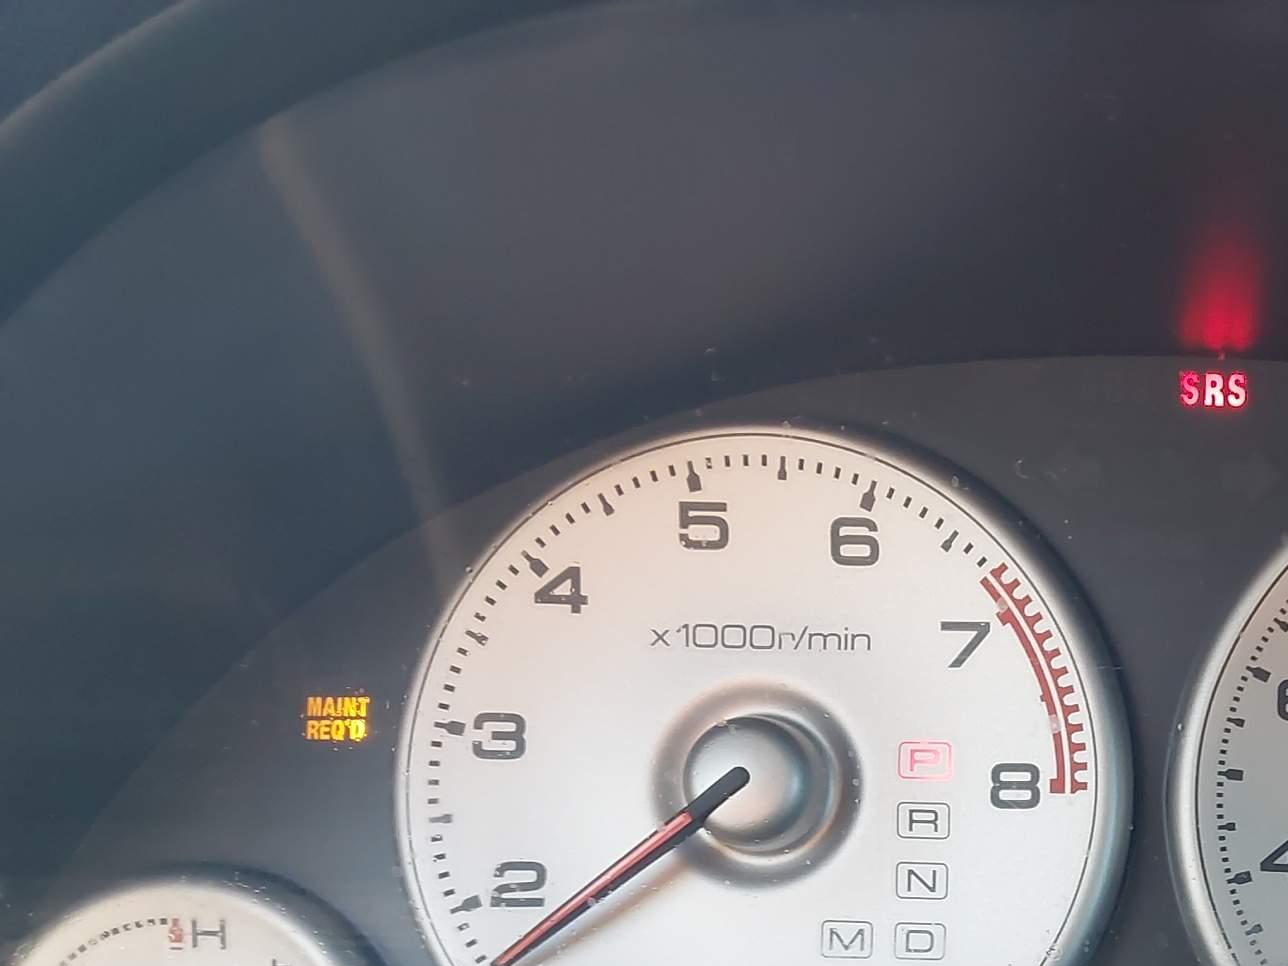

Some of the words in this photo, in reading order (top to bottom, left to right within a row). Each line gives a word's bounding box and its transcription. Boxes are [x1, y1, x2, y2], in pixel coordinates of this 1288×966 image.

[1180, 370, 1247, 407] SRS
[678, 501, 728, 550] 5
[830, 517, 880, 566] 6
[534, 566, 588, 614] 4
[940, 621, 991, 669] 7
[307, 695, 370, 718] MAINT
[307, 719, 366, 742] REQ'D
[472, 712, 527, 761] 3
[908, 749, 941, 773] P
[990, 763, 1041, 810] 8
[909, 810, 939, 832] R
[491, 861, 548, 908] 2
[908, 870, 937, 892] N
[192, 918, 227, 950] H
[829, 929, 866, 951] M
[906, 931, 934, 953] D
